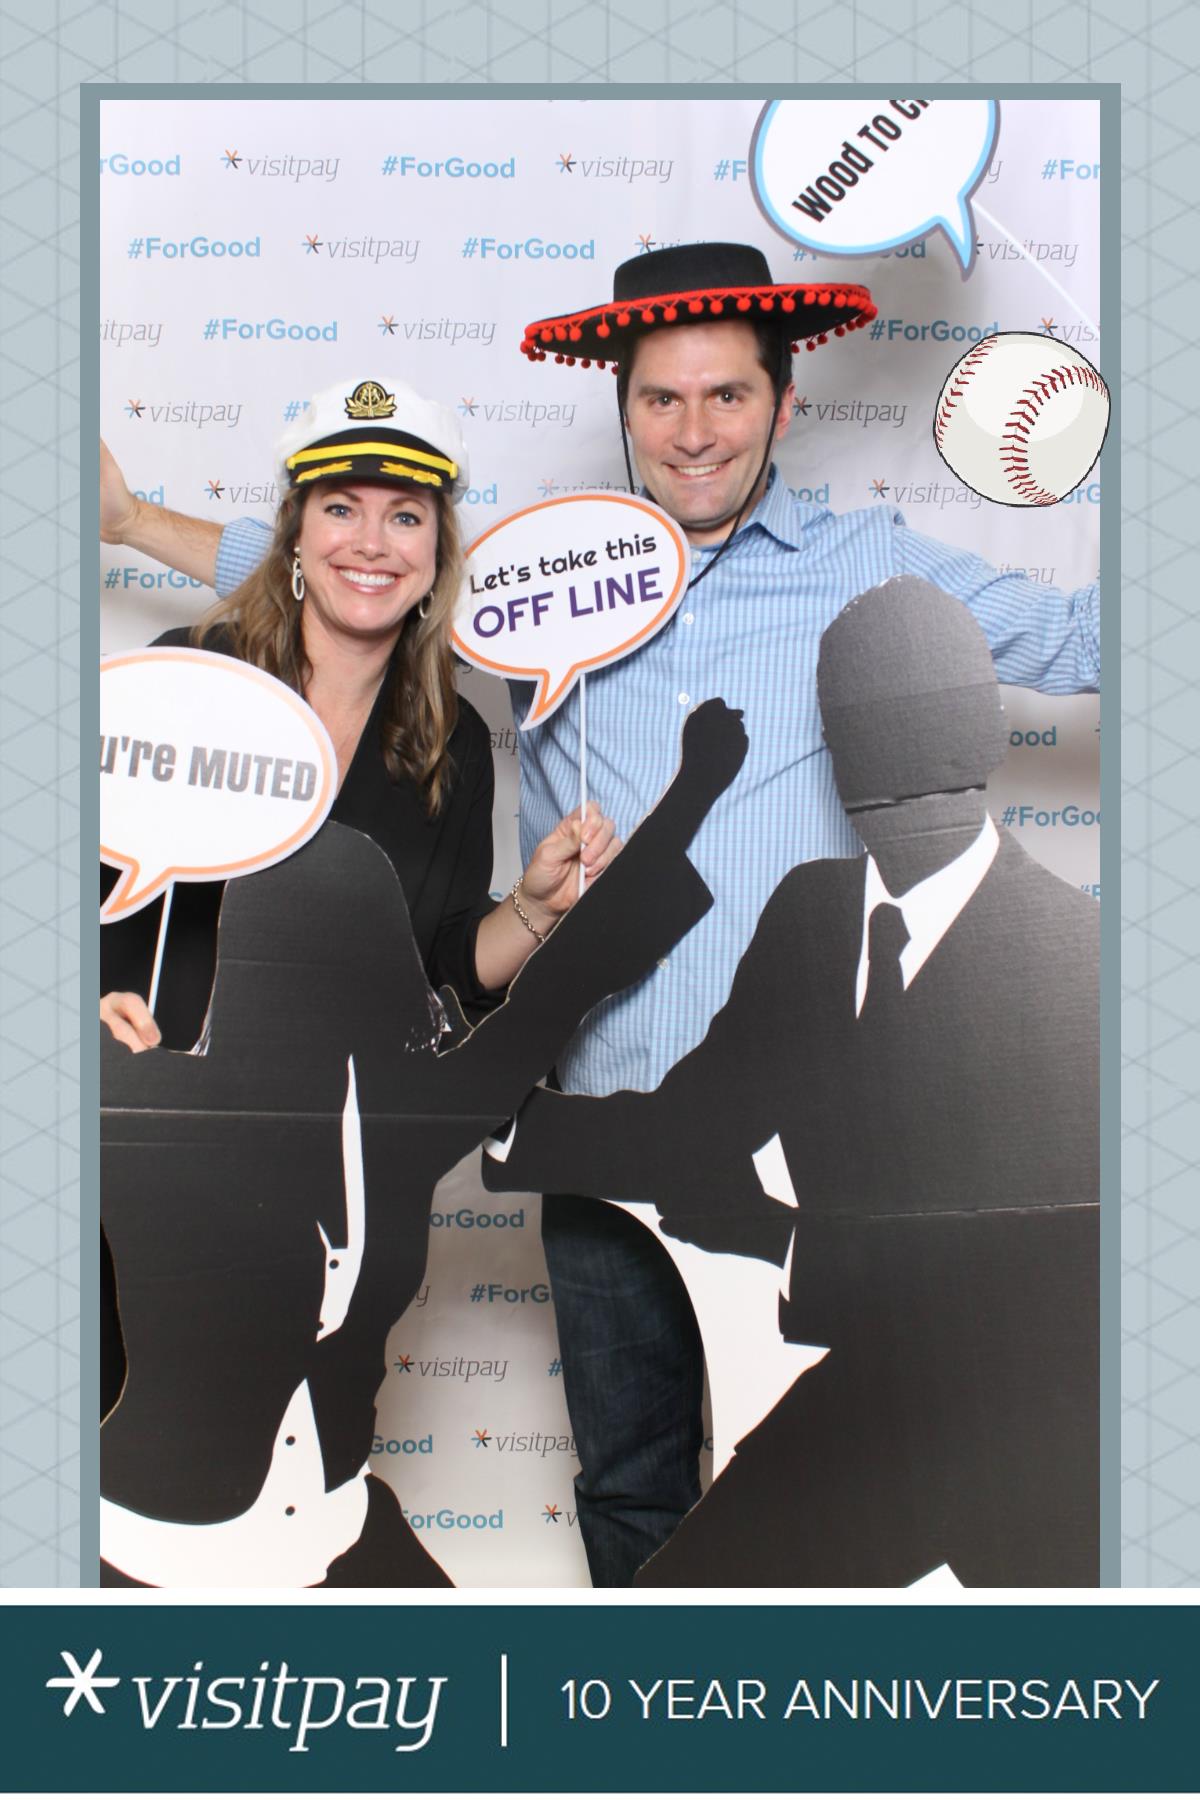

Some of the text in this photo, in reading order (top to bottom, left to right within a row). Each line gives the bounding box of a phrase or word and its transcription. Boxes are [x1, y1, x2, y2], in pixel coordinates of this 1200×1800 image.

[100, 154, 181, 176] rGood
[247, 155, 340, 183] visitpay
[381, 155, 516, 178] #ForGood
[581, 156, 675, 184] visitpay
[1041, 159, 1100, 181] #For
[127, 236, 261, 259] #ForGood
[327, 236, 420, 264] visitpay
[461, 237, 595, 260] #ForGood
[100, 319, 163, 347] itpay
[203, 318, 338, 342] #ForGood
[403, 318, 497, 345] visitpay
[150, 401, 243, 429] visitpay
[484, 400, 577, 427] visitpay
[815, 400, 908, 428] visitpay
[229, 481, 278, 504] visit
[470, 533, 657, 595] Let's take this
[472, 566, 664, 639] OFF LINE
[100, 735, 318, 802] u're MUTED
[1001, 805, 1100, 828] #ForGo
[428, 1209, 525, 1229] orGood
[470, 1283, 550, 1304] #ForG
[417, 1356, 509, 1383] visitpay
[368, 1434, 433, 1455] Good
[402, 1510, 504, 1530] orGood
